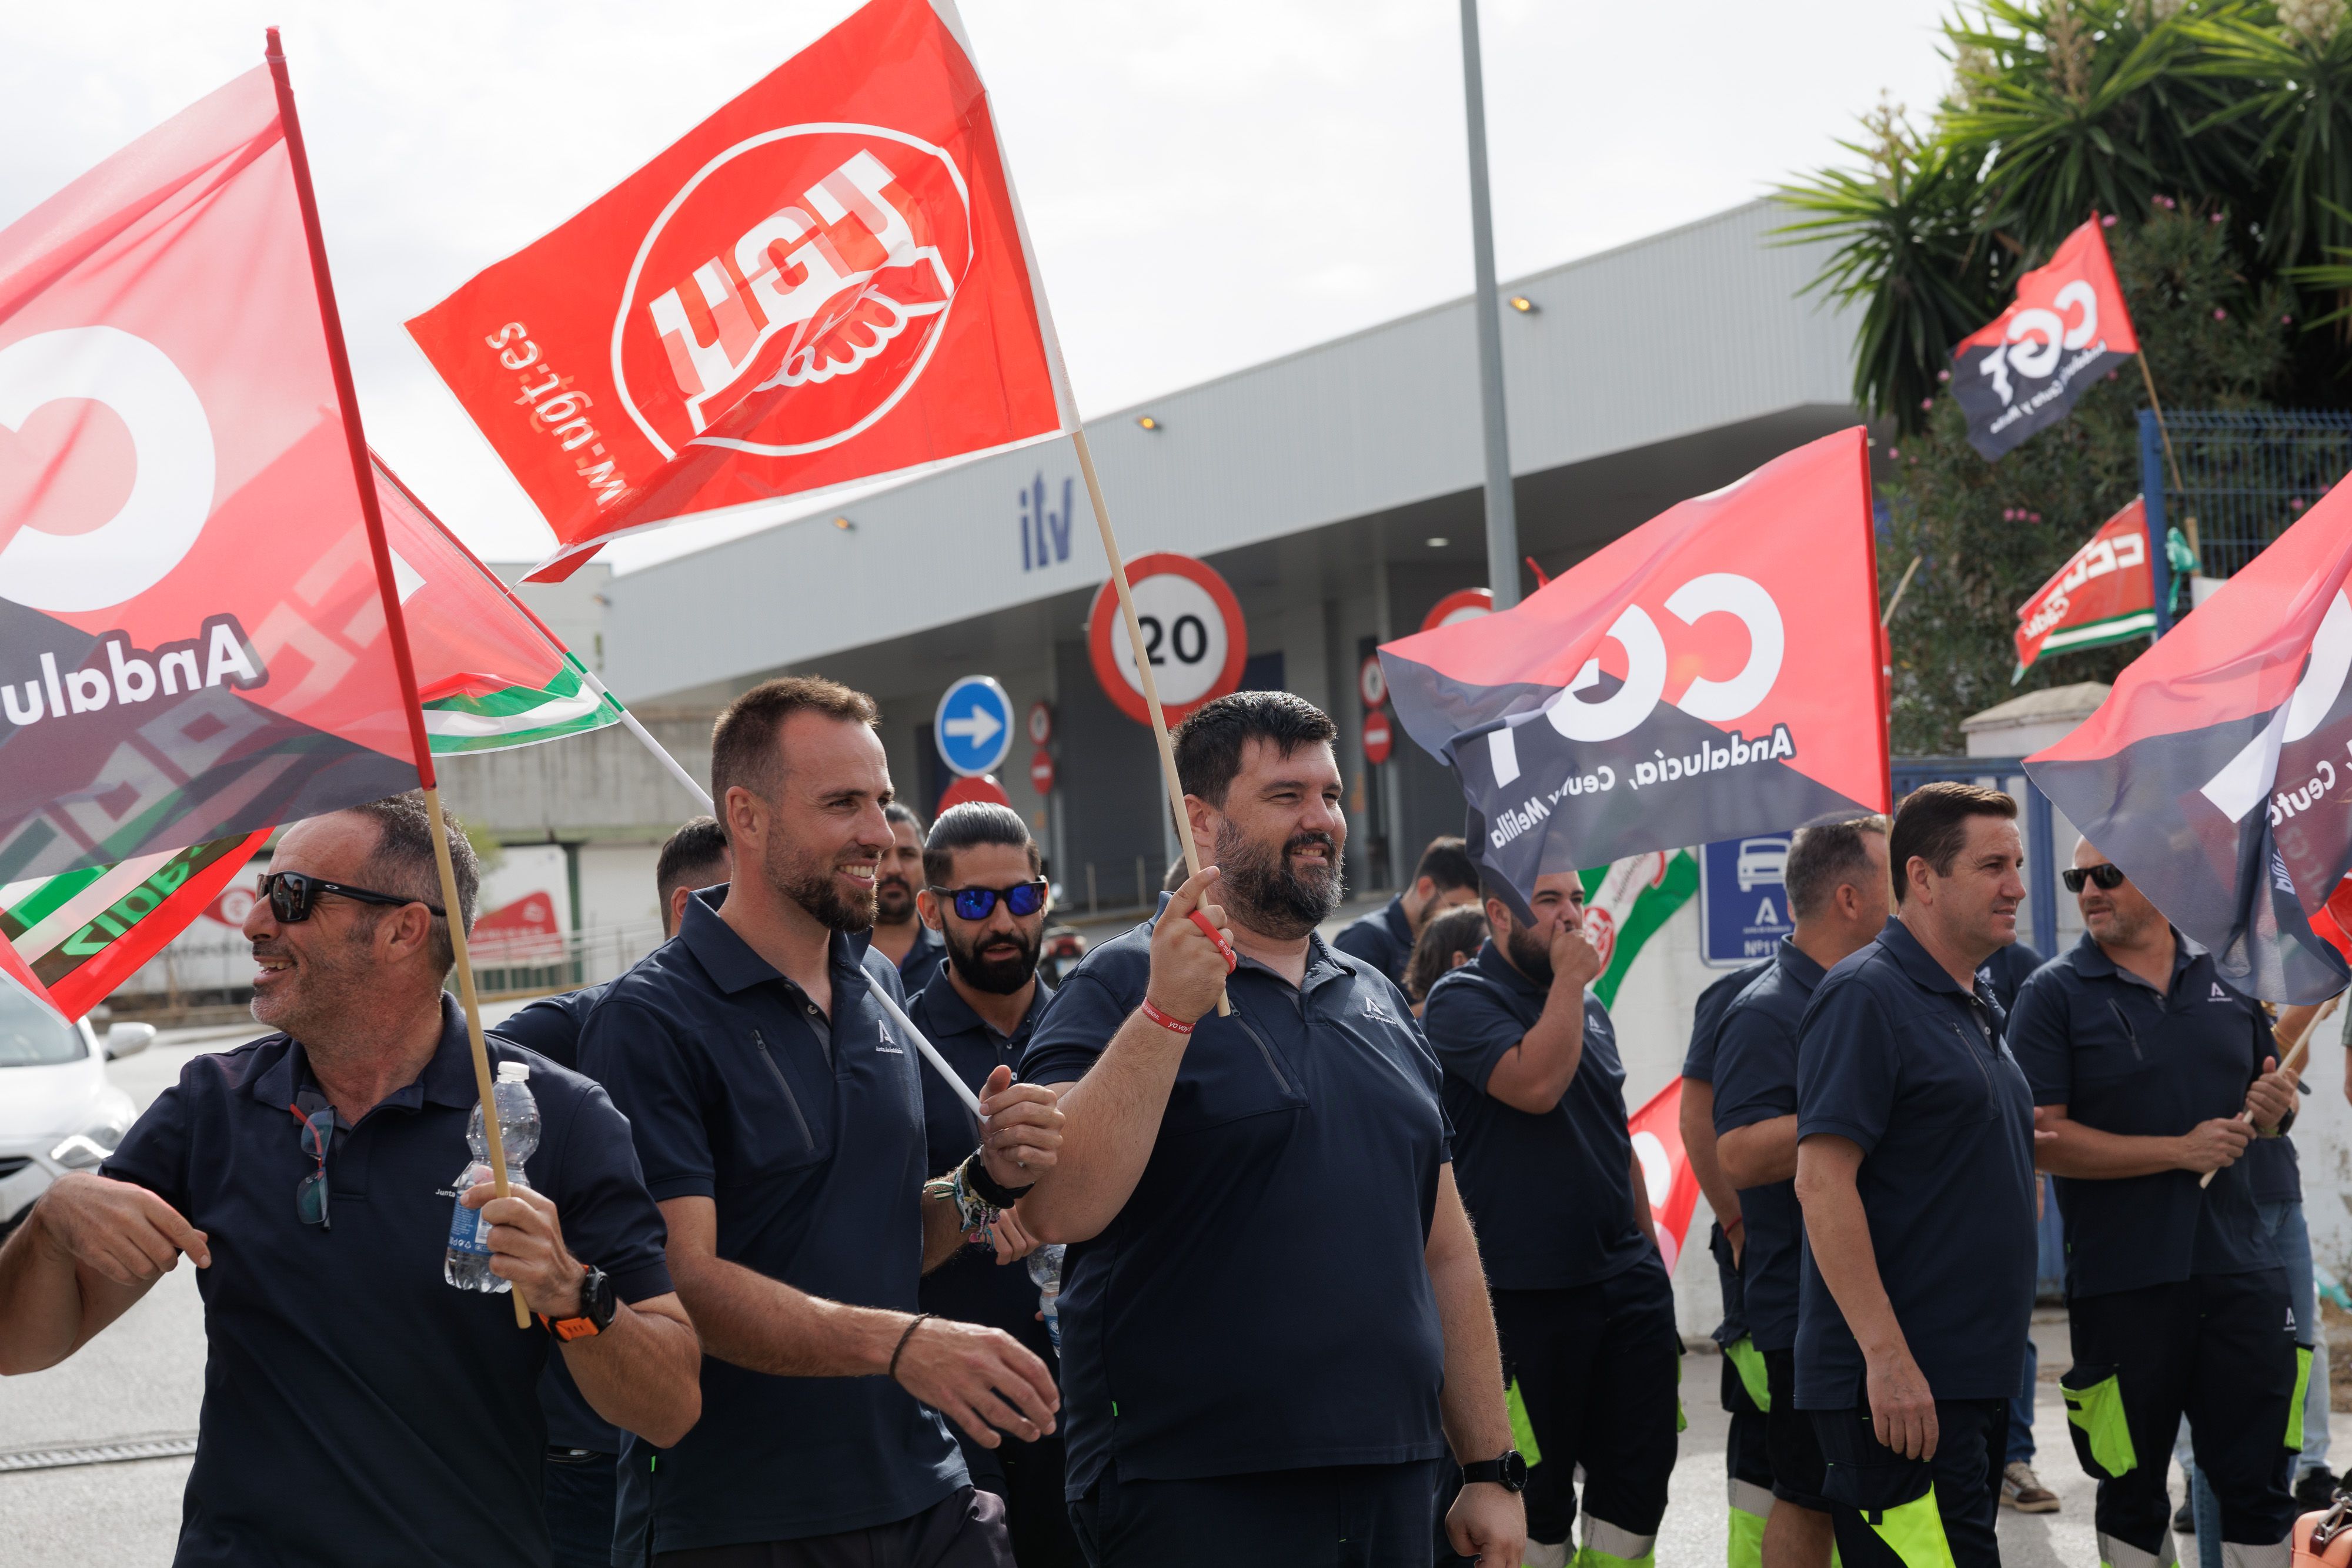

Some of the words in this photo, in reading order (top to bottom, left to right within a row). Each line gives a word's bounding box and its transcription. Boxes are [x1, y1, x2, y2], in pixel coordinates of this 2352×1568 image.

[649, 149, 917, 395] UGT
[1020, 472, 1074, 571] itv
[1134, 614, 1207, 666] 20
[1147, 1008, 1160, 1021] GENERAL
[435, 1188, 456, 1198] Junta
